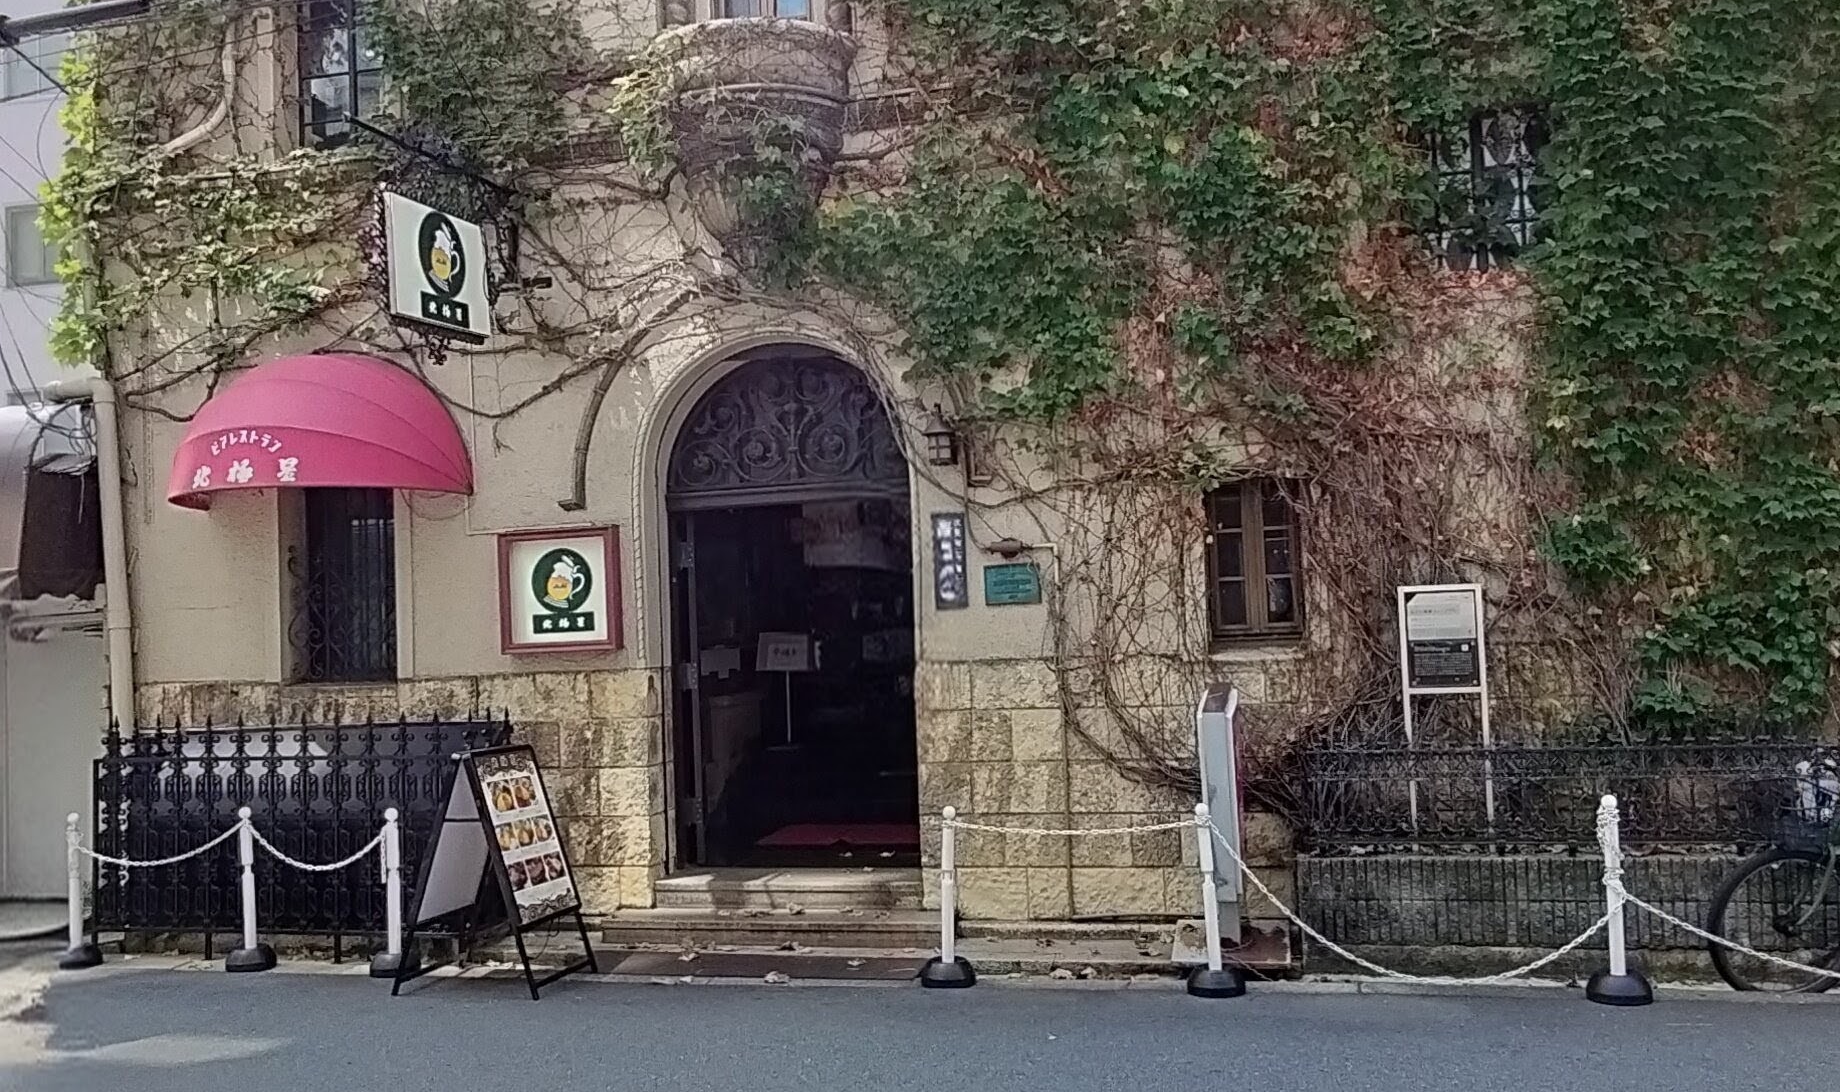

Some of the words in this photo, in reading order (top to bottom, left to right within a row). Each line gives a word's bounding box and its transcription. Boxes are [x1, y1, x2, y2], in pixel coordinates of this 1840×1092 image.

[211, 430, 282, 456] ビアレストラン
[193, 457, 299, 489] 北極星
